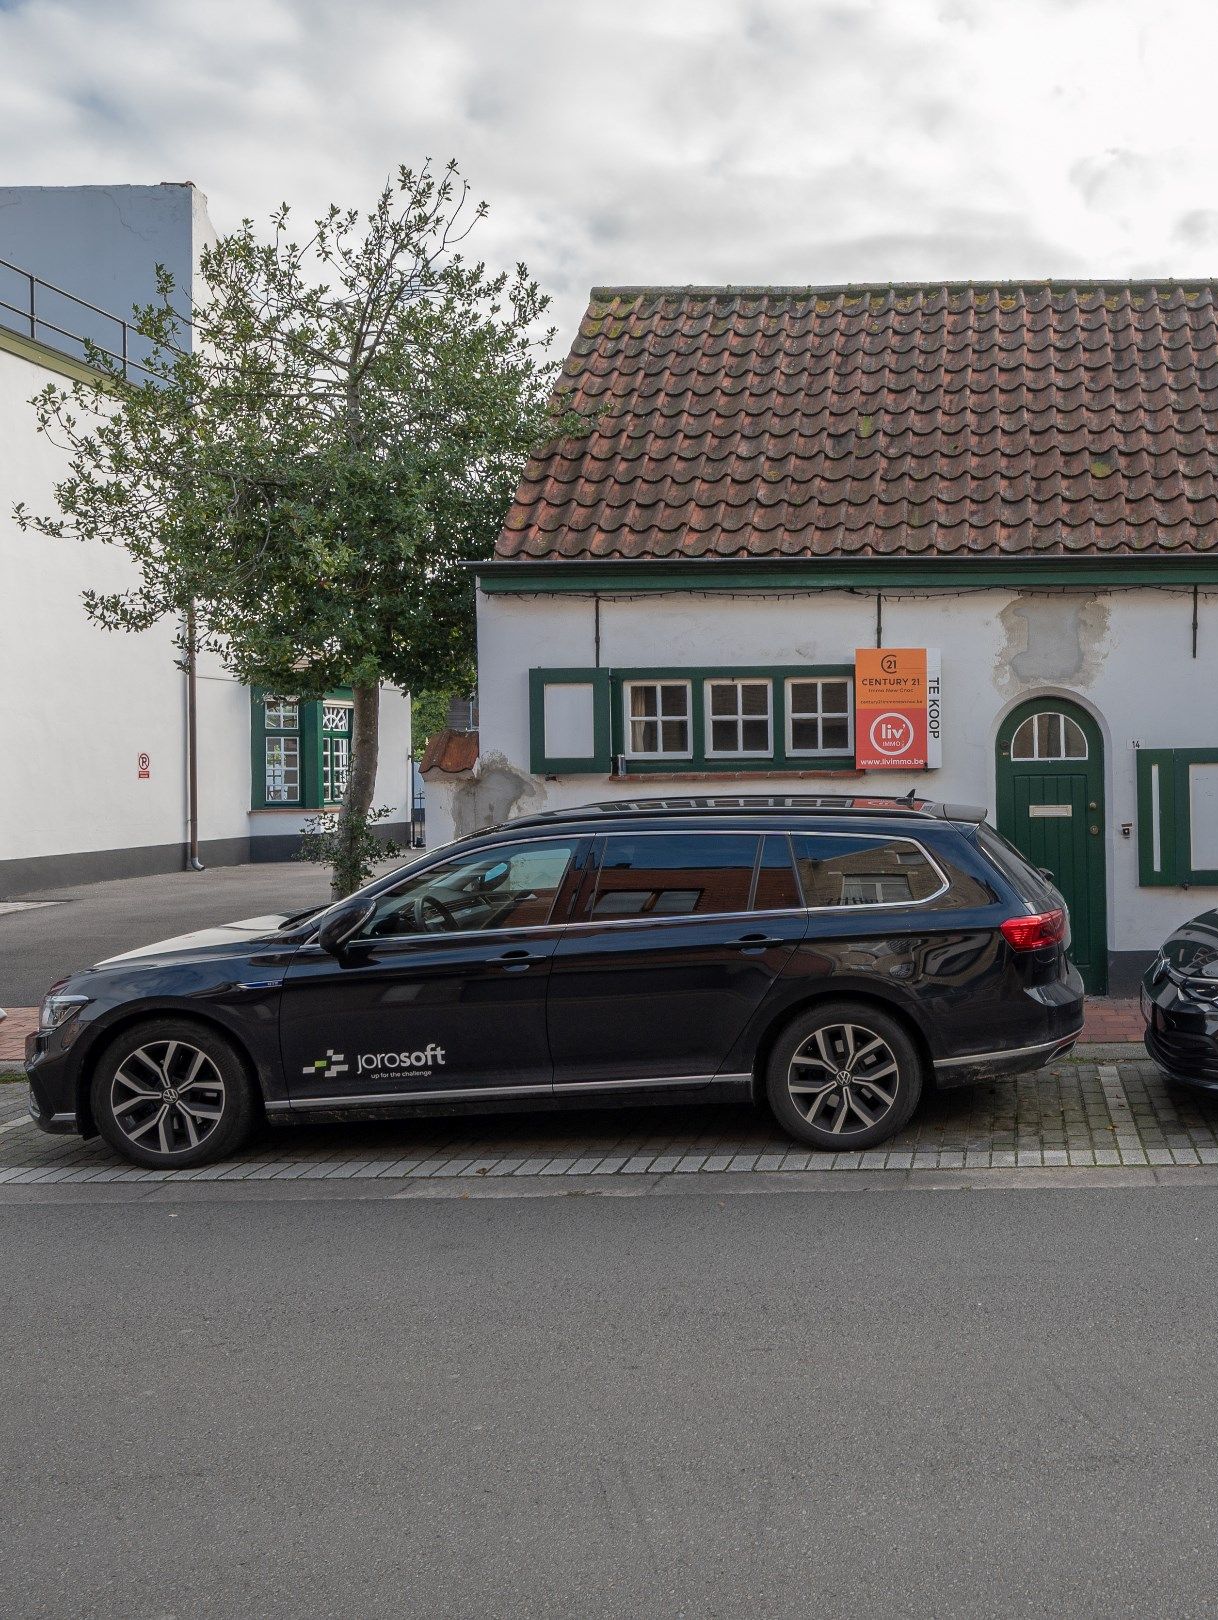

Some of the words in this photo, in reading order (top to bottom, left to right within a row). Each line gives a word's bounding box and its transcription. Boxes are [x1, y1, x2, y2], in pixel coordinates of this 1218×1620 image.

[861, 678, 909, 686] CENTURY
[911, 678, 920, 686] 21
[928, 677, 939, 695] TE
[928, 699, 940, 739] KOOP
[1132, 740, 1140, 748] 14
[860, 757, 924, 765] www.livimmo.be
[356, 1043, 446, 1074] jorosoft
